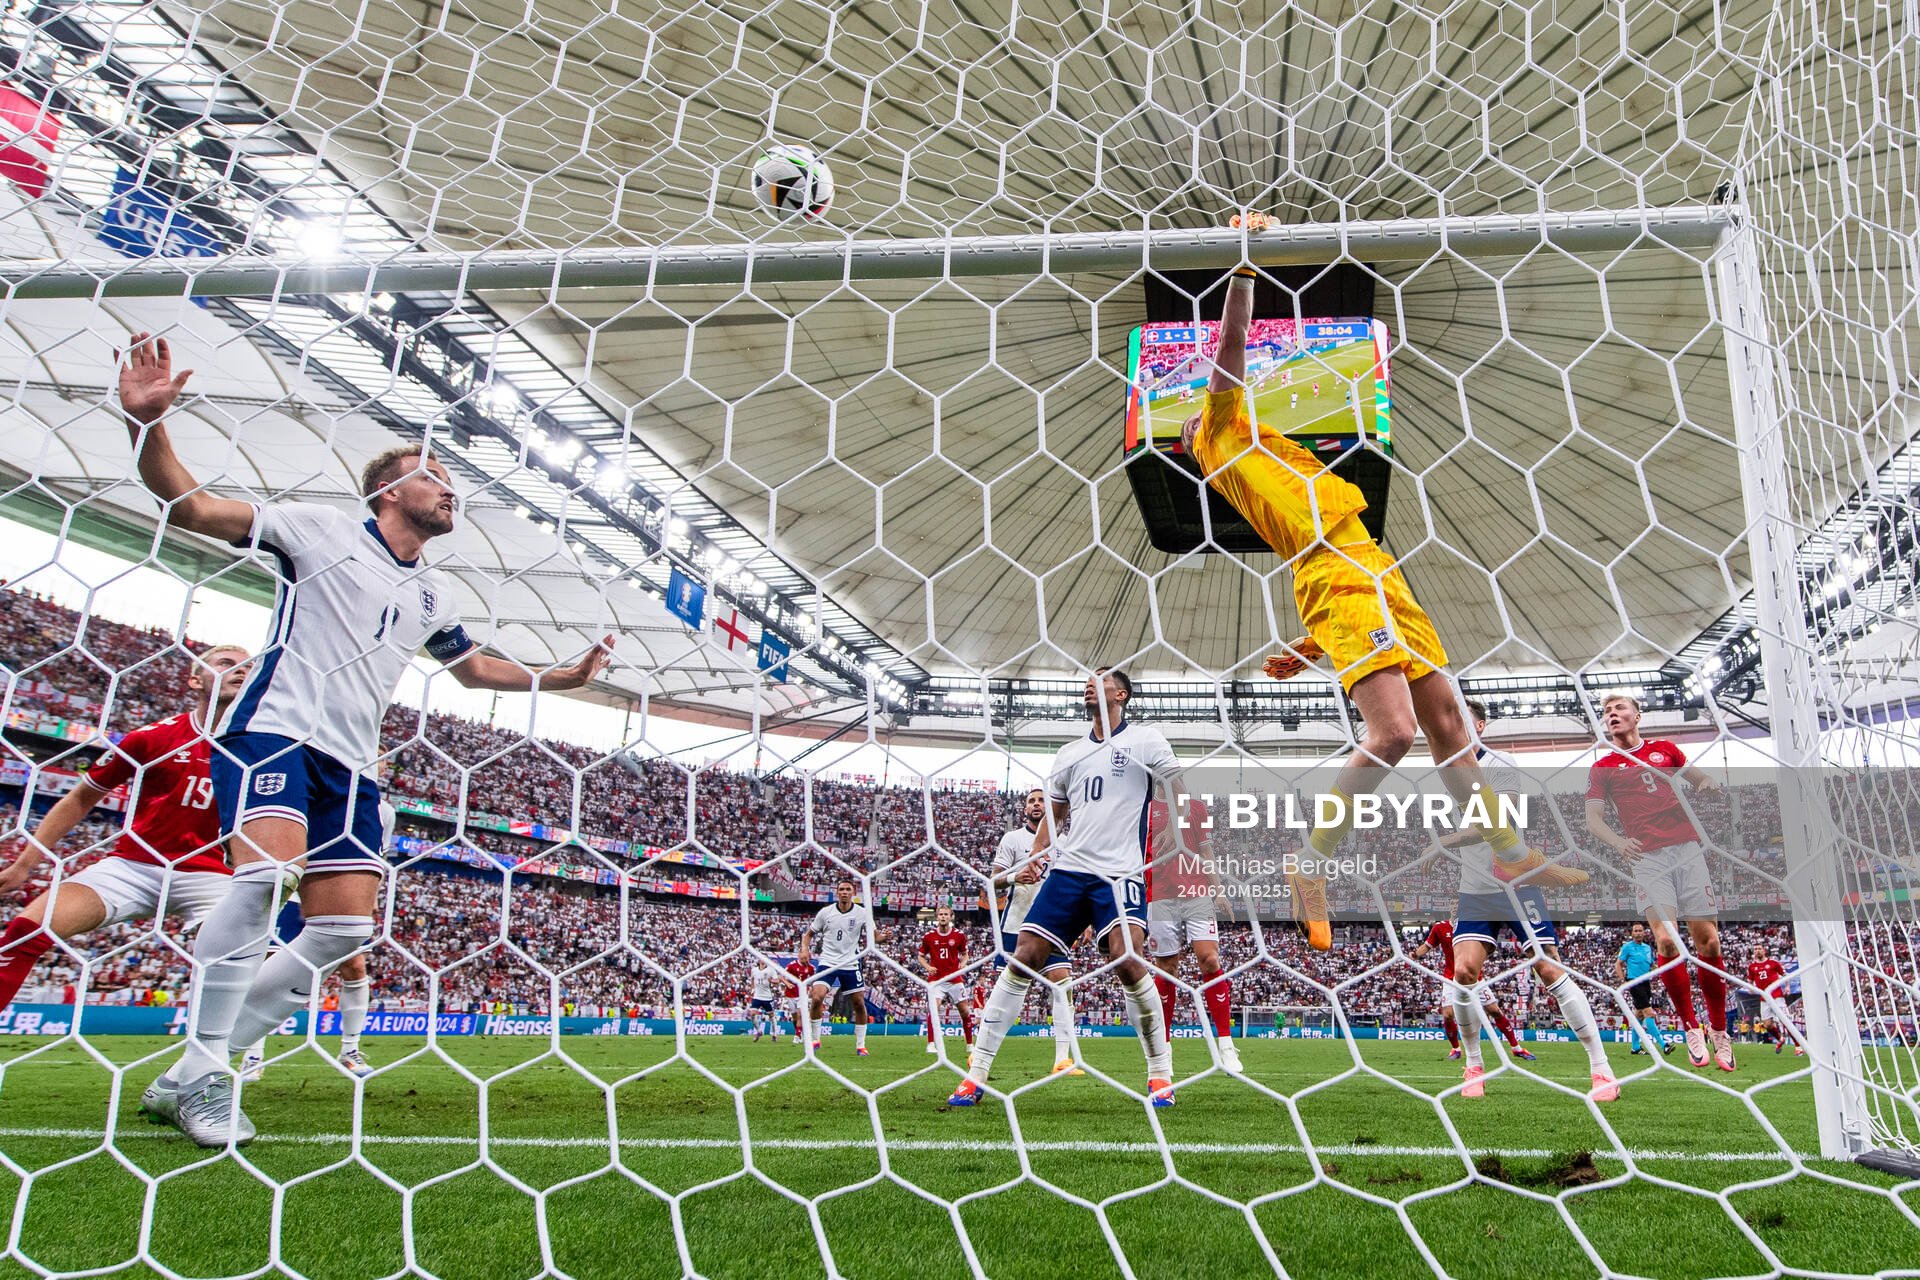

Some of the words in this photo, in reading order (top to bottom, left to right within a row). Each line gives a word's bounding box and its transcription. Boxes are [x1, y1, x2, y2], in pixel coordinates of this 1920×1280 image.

[762, 643, 785, 670] FIFA
[181, 775, 215, 810] 19
[1084, 775, 1104, 803] 10
[1641, 771, 1658, 793] 9
[1040, 862, 1048, 879] 2
[1119, 880, 1141, 906] 10
[1523, 899, 1542, 925] 5
[836, 929, 843, 941] 8
[939, 947, 949, 959] 21
[855, 970, 863, 982] 8
[483, 1014, 552, 1035] Hisense
[684, 1020, 724, 1035] Hisense
[1378, 1027, 1445, 1040] Hisense
